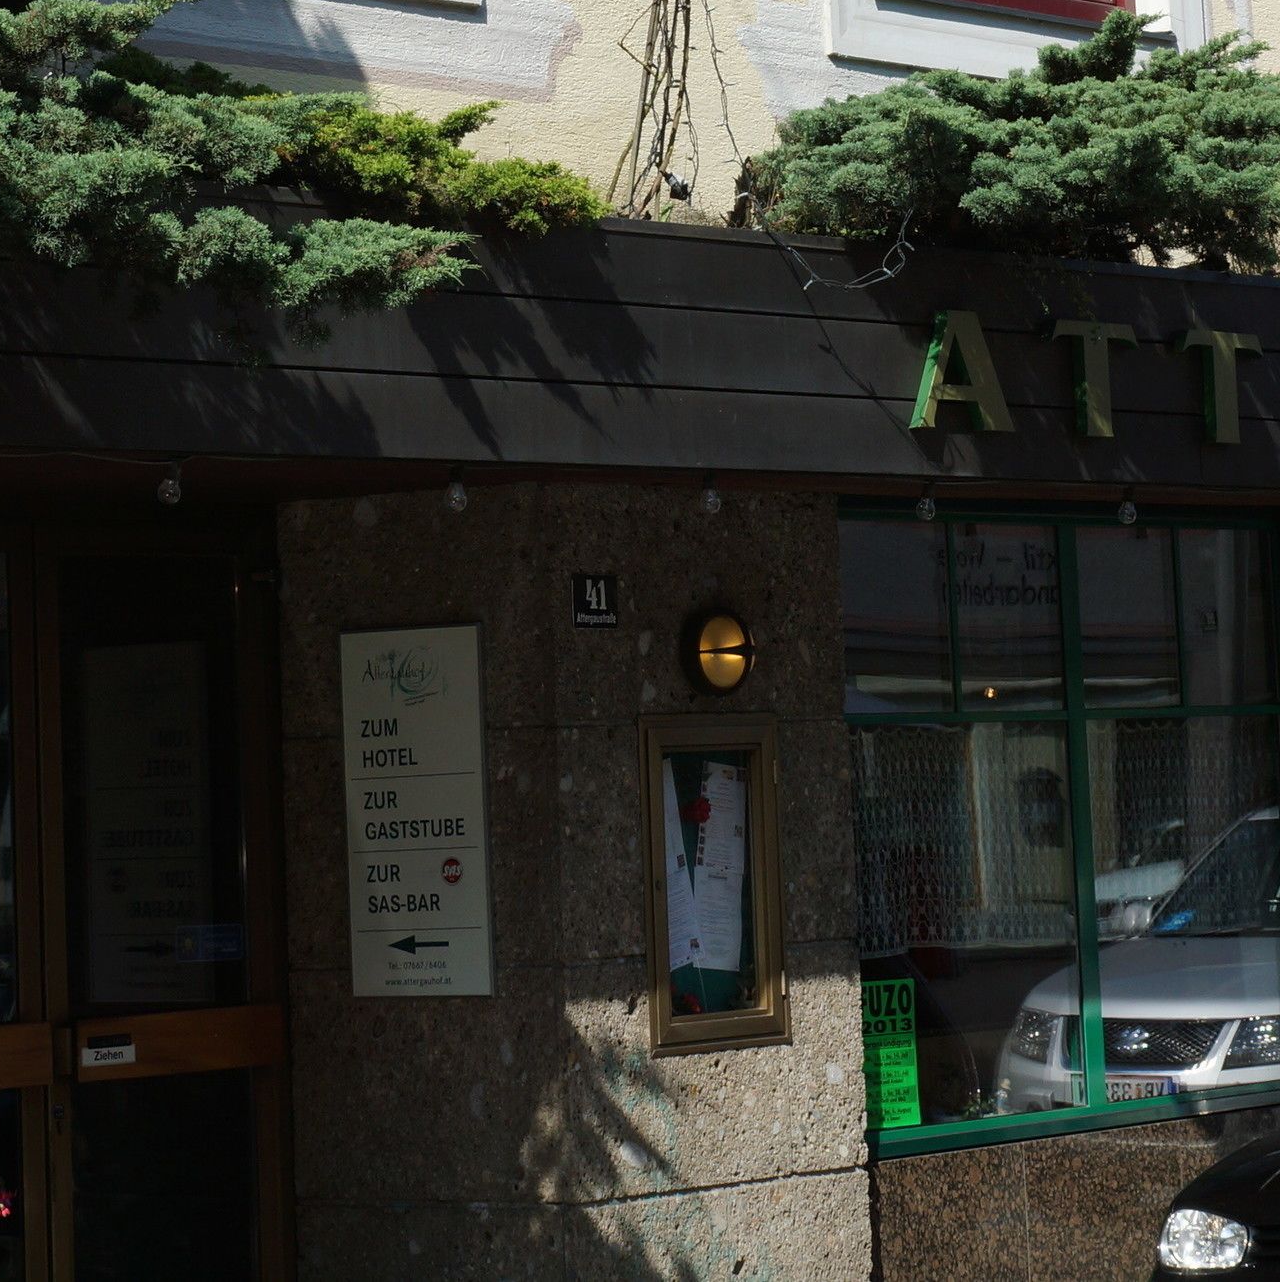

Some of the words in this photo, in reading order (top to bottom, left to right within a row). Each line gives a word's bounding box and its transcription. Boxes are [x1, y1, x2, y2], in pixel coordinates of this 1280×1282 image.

[586, 579, 608, 610] 41
[361, 718, 398, 738] ZUM
[363, 748, 418, 769] HOTEL
[364, 790, 398, 810] ZUR
[365, 818, 466, 840] GASTSTUBE
[367, 863, 401, 883] ZUR
[368, 893, 441, 914] SAS-BAR
[862, 1018, 913, 1035] 2013
[94, 1049, 124, 1061] Ziehen
